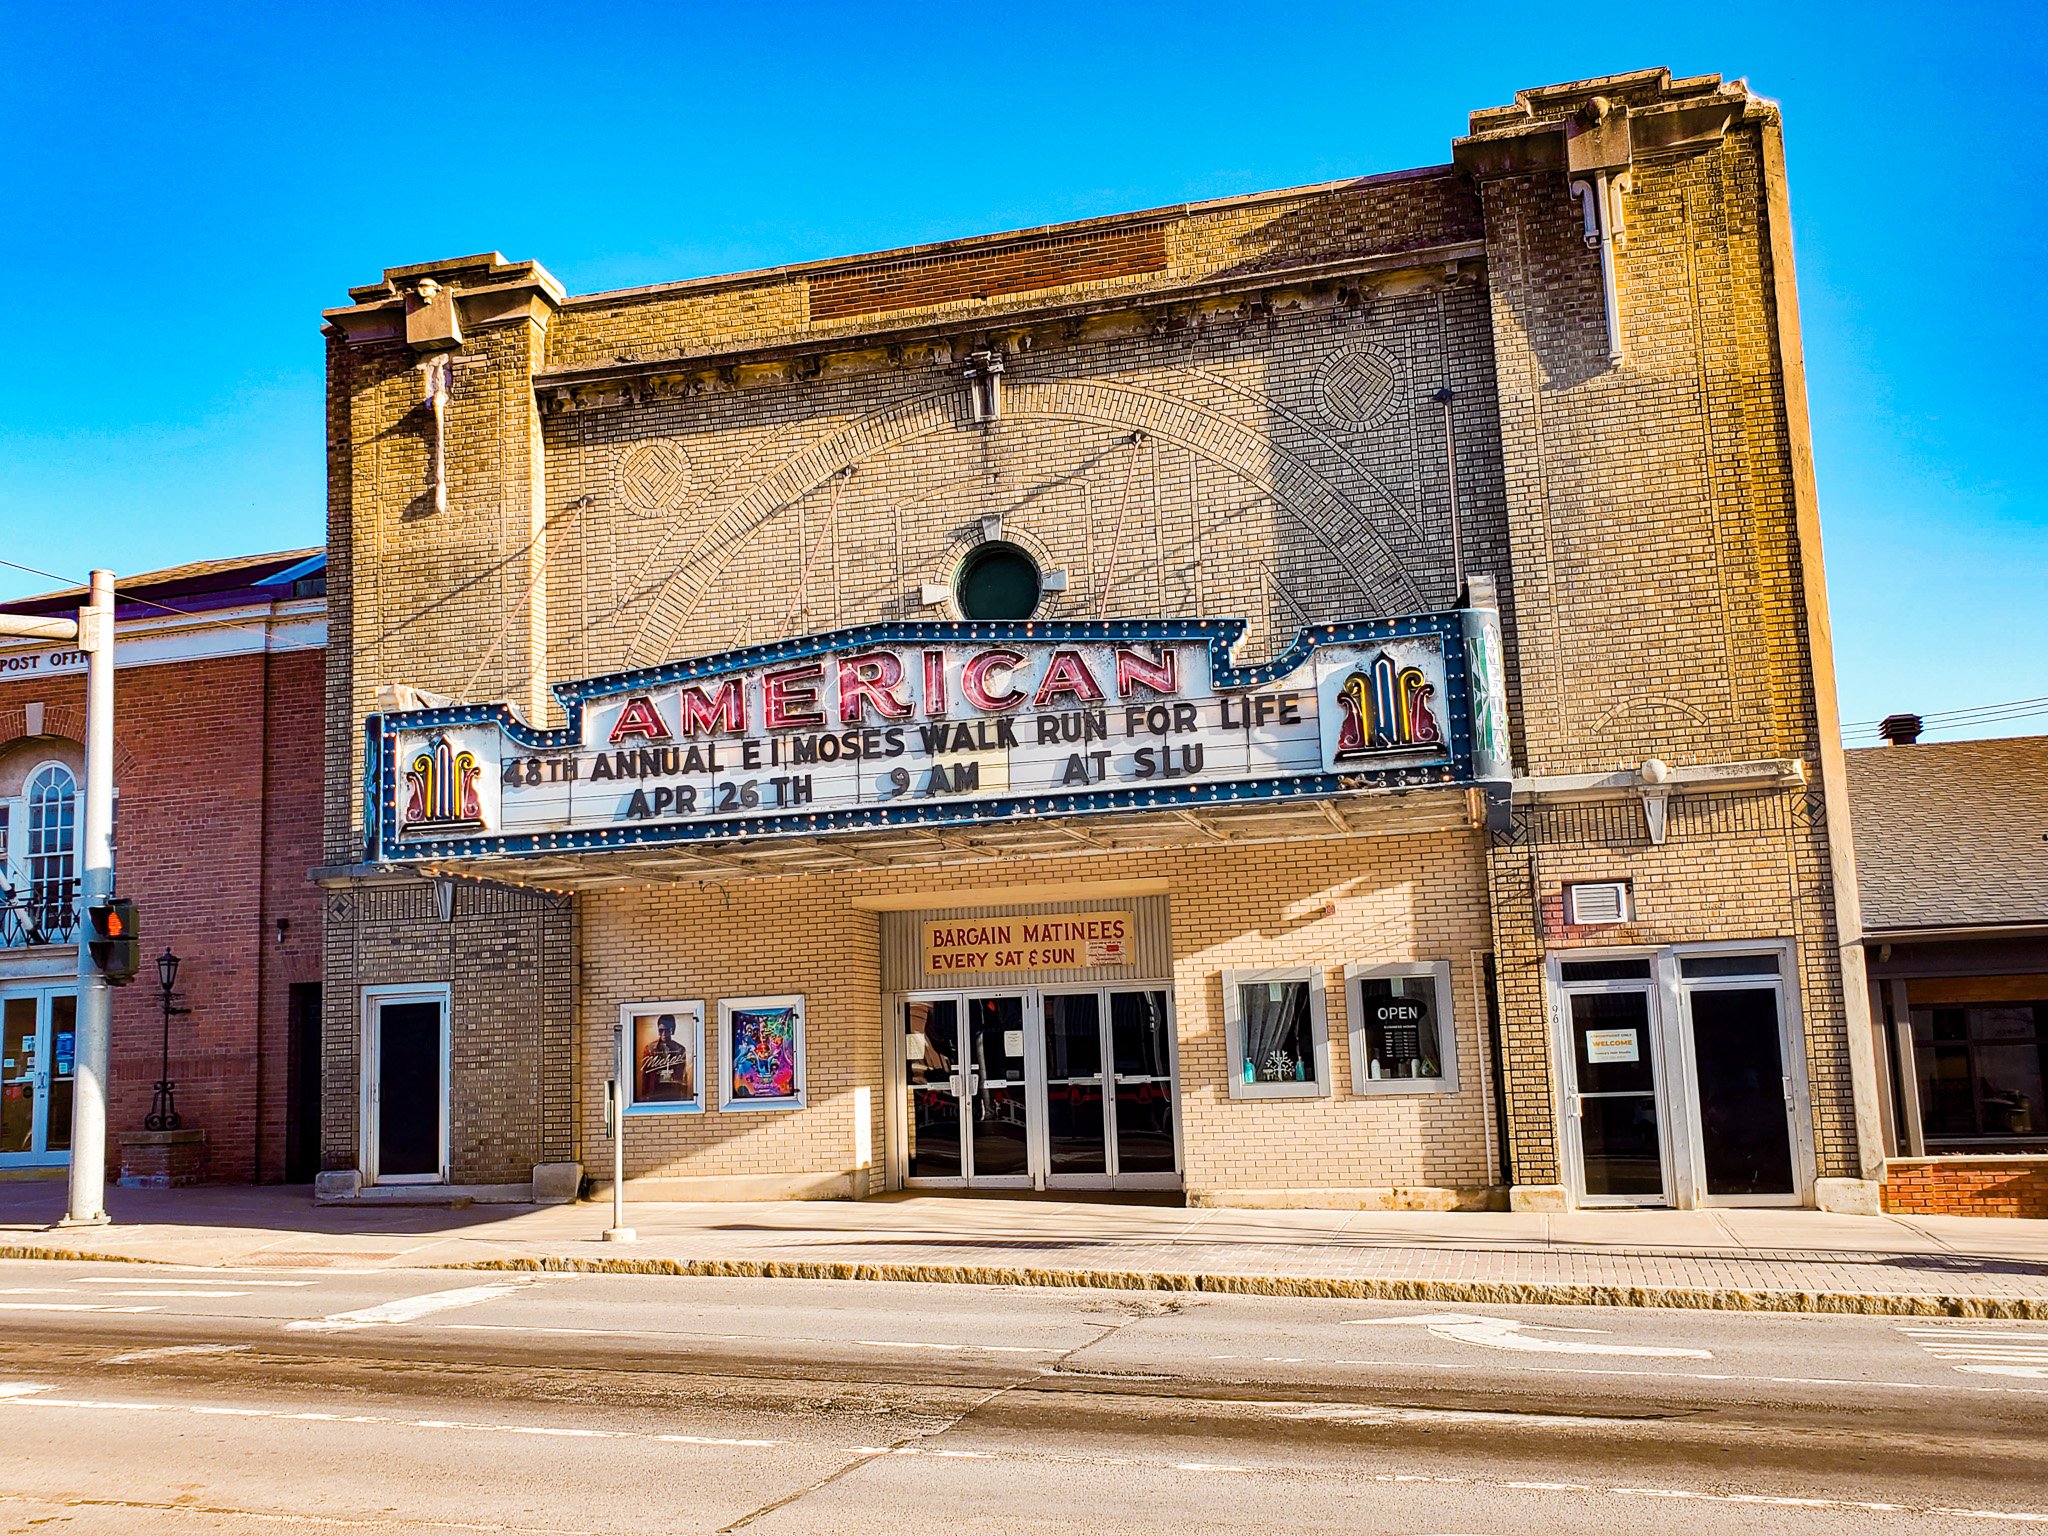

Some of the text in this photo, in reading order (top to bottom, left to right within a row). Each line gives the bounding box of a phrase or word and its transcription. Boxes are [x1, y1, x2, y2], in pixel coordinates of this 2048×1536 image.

[0, 655, 40, 672] POST
[609, 648, 1179, 743] AMERICAN
[503, 757, 579, 788] 48TH
[590, 743, 725, 782] ANNUAL
[793, 727, 906, 765] MOSES
[919, 717, 1019, 754] WALK
[1037, 711, 1108, 745] RUN
[1126, 702, 1198, 738] FOR
[1220, 693, 1301, 730] LIFE
[626, 784, 697, 818] APR
[889, 767, 910, 796] 9
[926, 761, 980, 795] AM
[1062, 750, 1111, 785] AT
[1134, 742, 1205, 778] SLU
[933, 919, 1125, 948] BARGAIN MATINEES
[932, 952, 989, 970] EVERY
[994, 950, 1025, 966] SAT
[1028, 949, 1038, 967] &
[1042, 948, 1075, 964] SUN
[1377, 1006, 1418, 1020] OPEN
[640, 1053, 686, 1073] Michael
